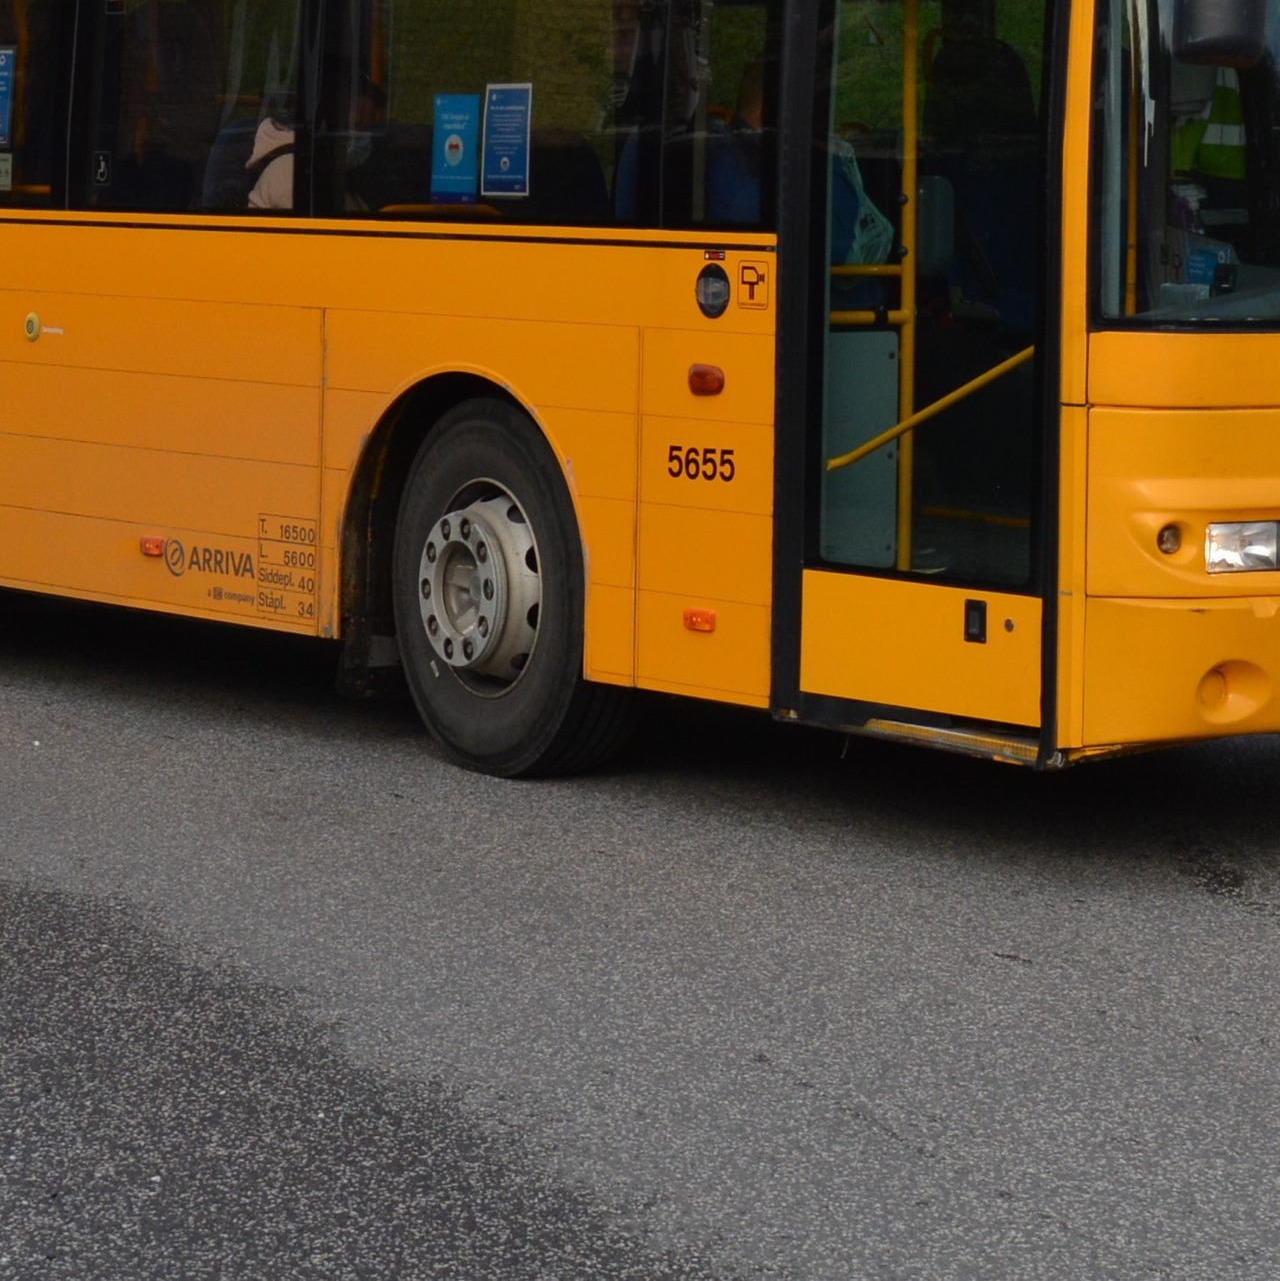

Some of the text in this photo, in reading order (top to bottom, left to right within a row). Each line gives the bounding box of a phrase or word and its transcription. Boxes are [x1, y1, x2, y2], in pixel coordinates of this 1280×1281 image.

[668, 445, 735, 482] 5655
[260, 519, 315, 543] T. 16500
[188, 545, 256, 579] ARRIVA
[260, 544, 315, 568] L. 5600
[258, 567, 314, 593] Siddepl. 40
[224, 590, 255, 606] company
[298, 601, 313, 617] 34
